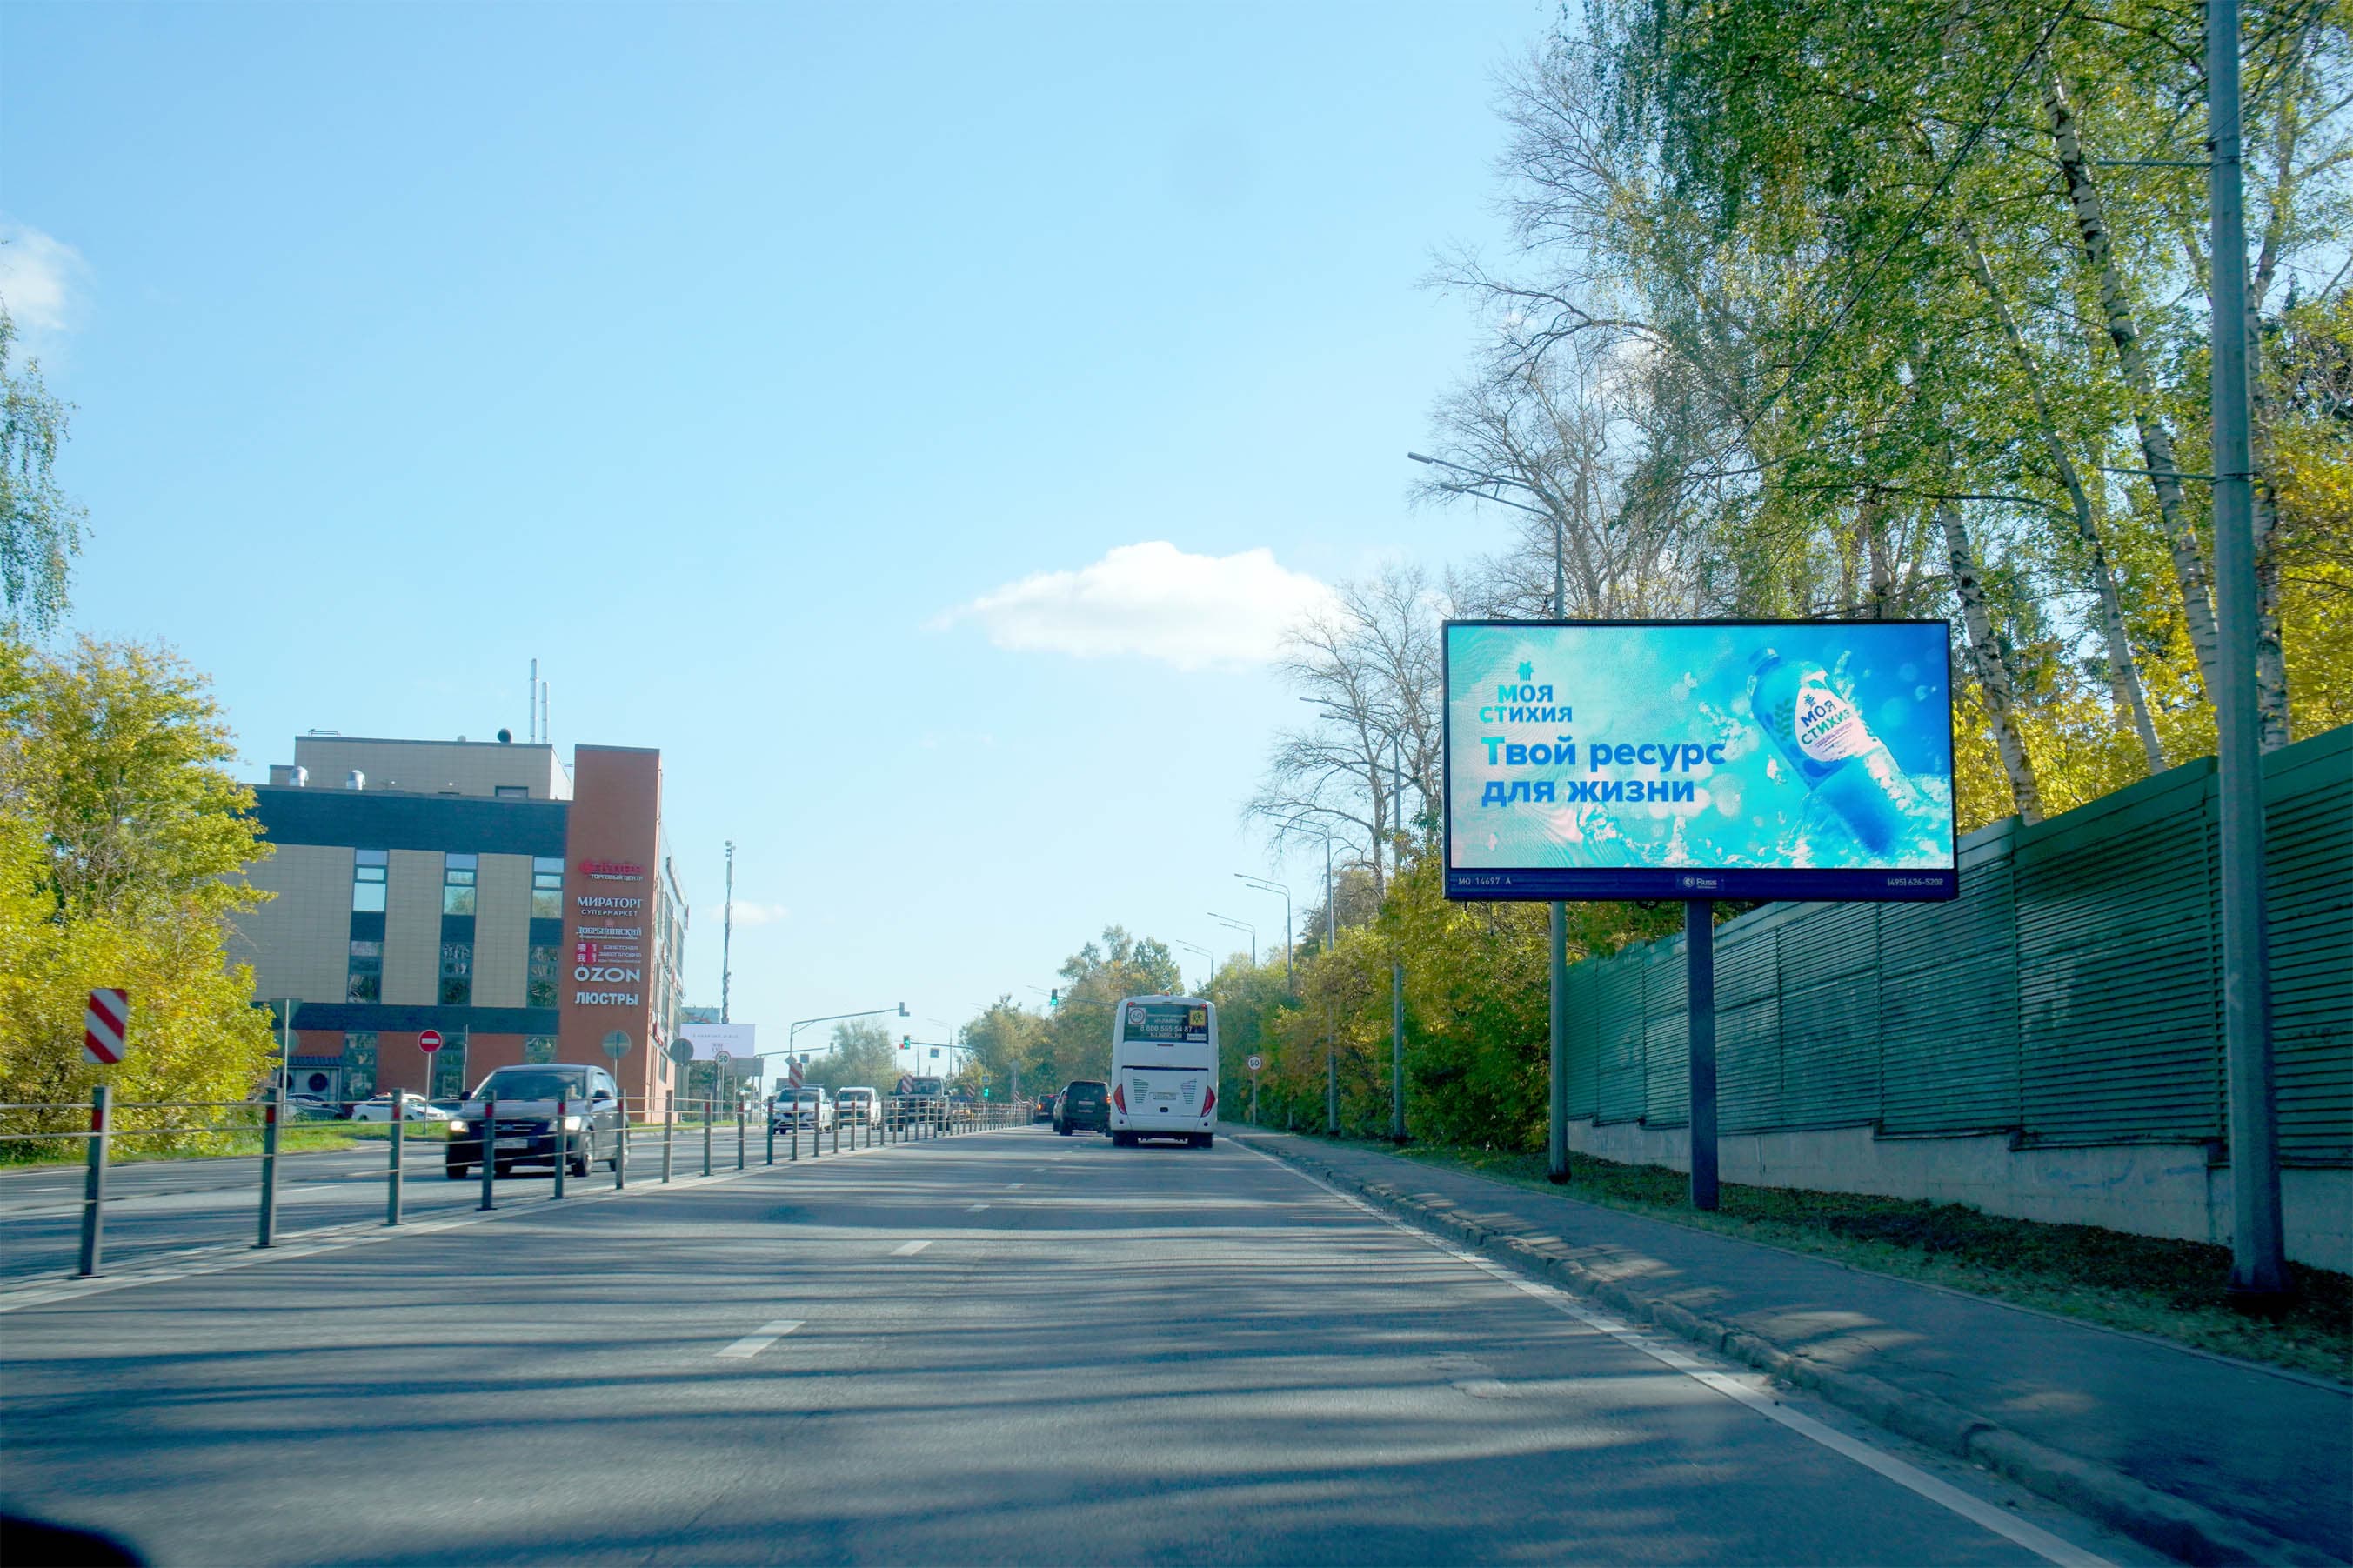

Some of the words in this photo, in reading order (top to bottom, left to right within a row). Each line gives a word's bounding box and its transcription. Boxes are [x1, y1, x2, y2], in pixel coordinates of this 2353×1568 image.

[1497, 684, 1553, 703] МОЯ
[1479, 706, 1573, 723] СТИХИЯ
[1801, 699, 1837, 728] МОЯ
[1481, 735, 1576, 765] Твой
[1590, 743, 1727, 772] ресурс
[1481, 781, 1555, 807] для
[1568, 780, 1695, 803] жизни
[577, 897, 644, 909] МИРАТОРГ
[574, 966, 641, 983] OZON
[575, 991, 640, 1006] ЛЮСТРЫ
